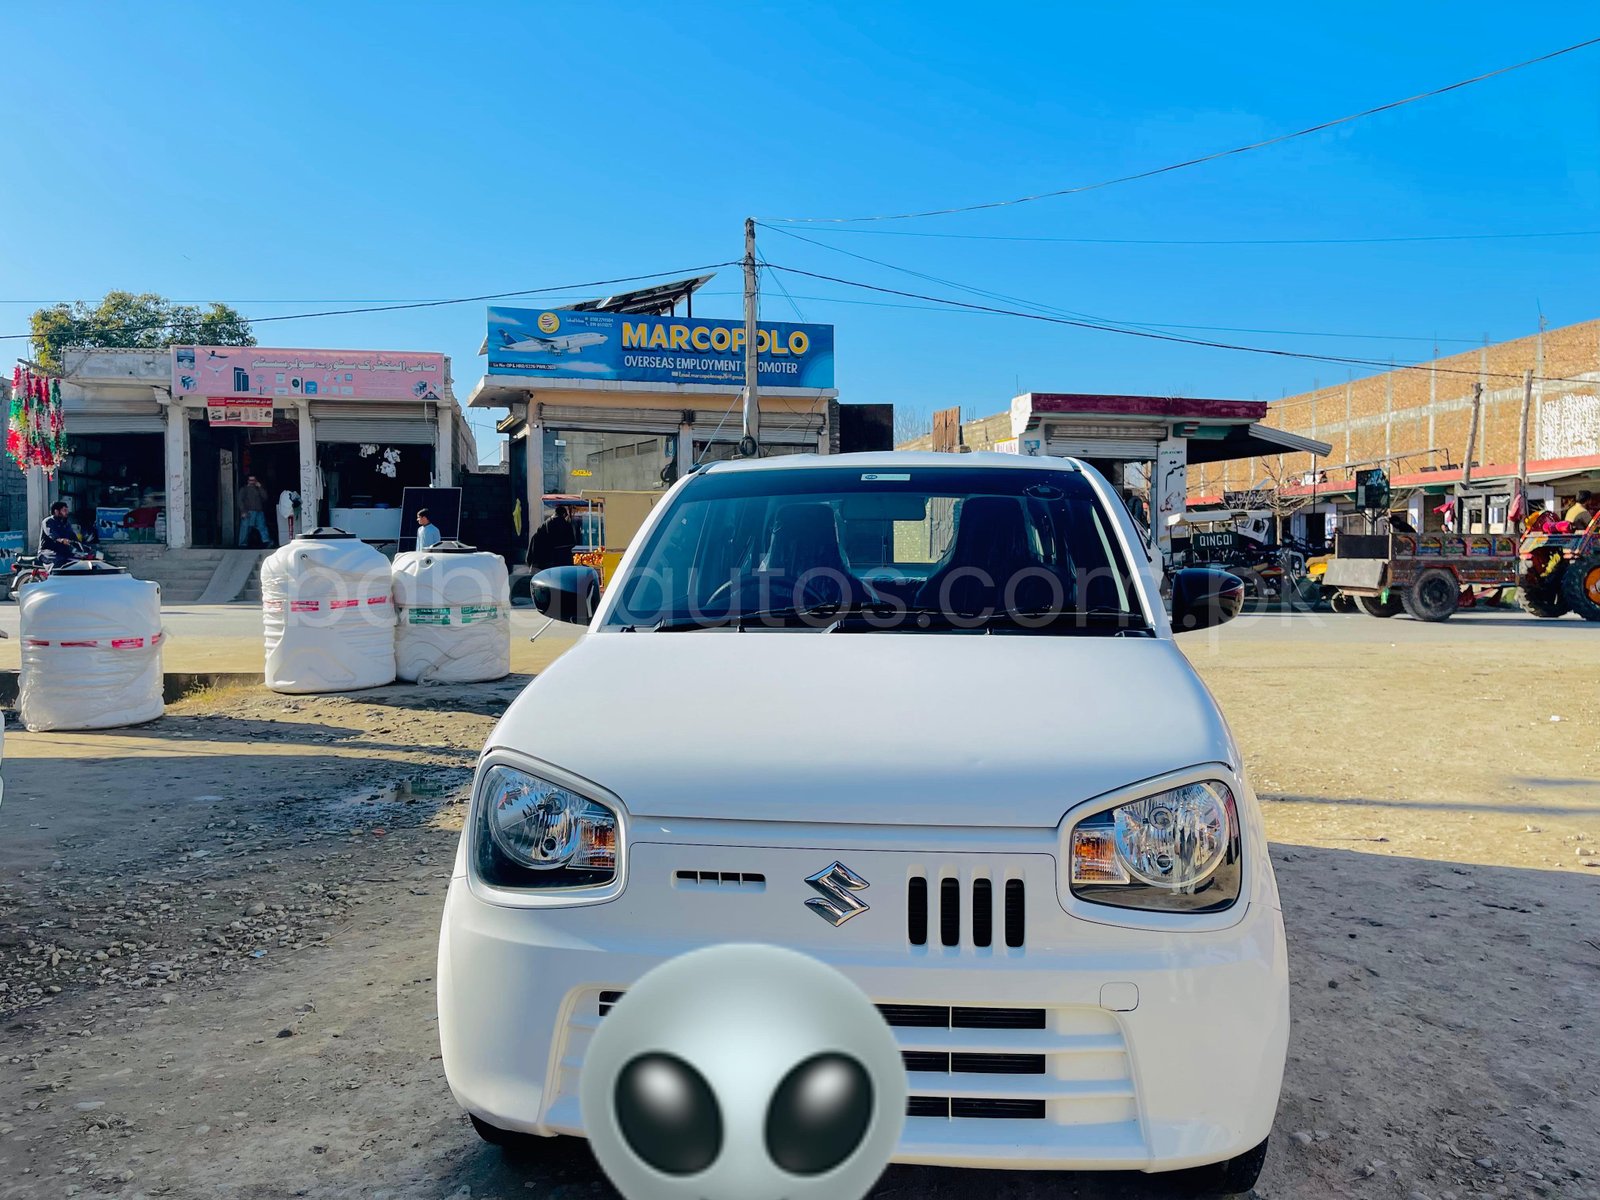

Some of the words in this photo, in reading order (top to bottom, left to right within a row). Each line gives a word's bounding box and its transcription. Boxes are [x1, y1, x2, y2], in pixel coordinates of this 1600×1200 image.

[621, 321, 809, 356] MARCOPOLO
[624, 355, 674, 369] OVERSEAS
[676, 357, 741, 372] EMPLOYMENT
